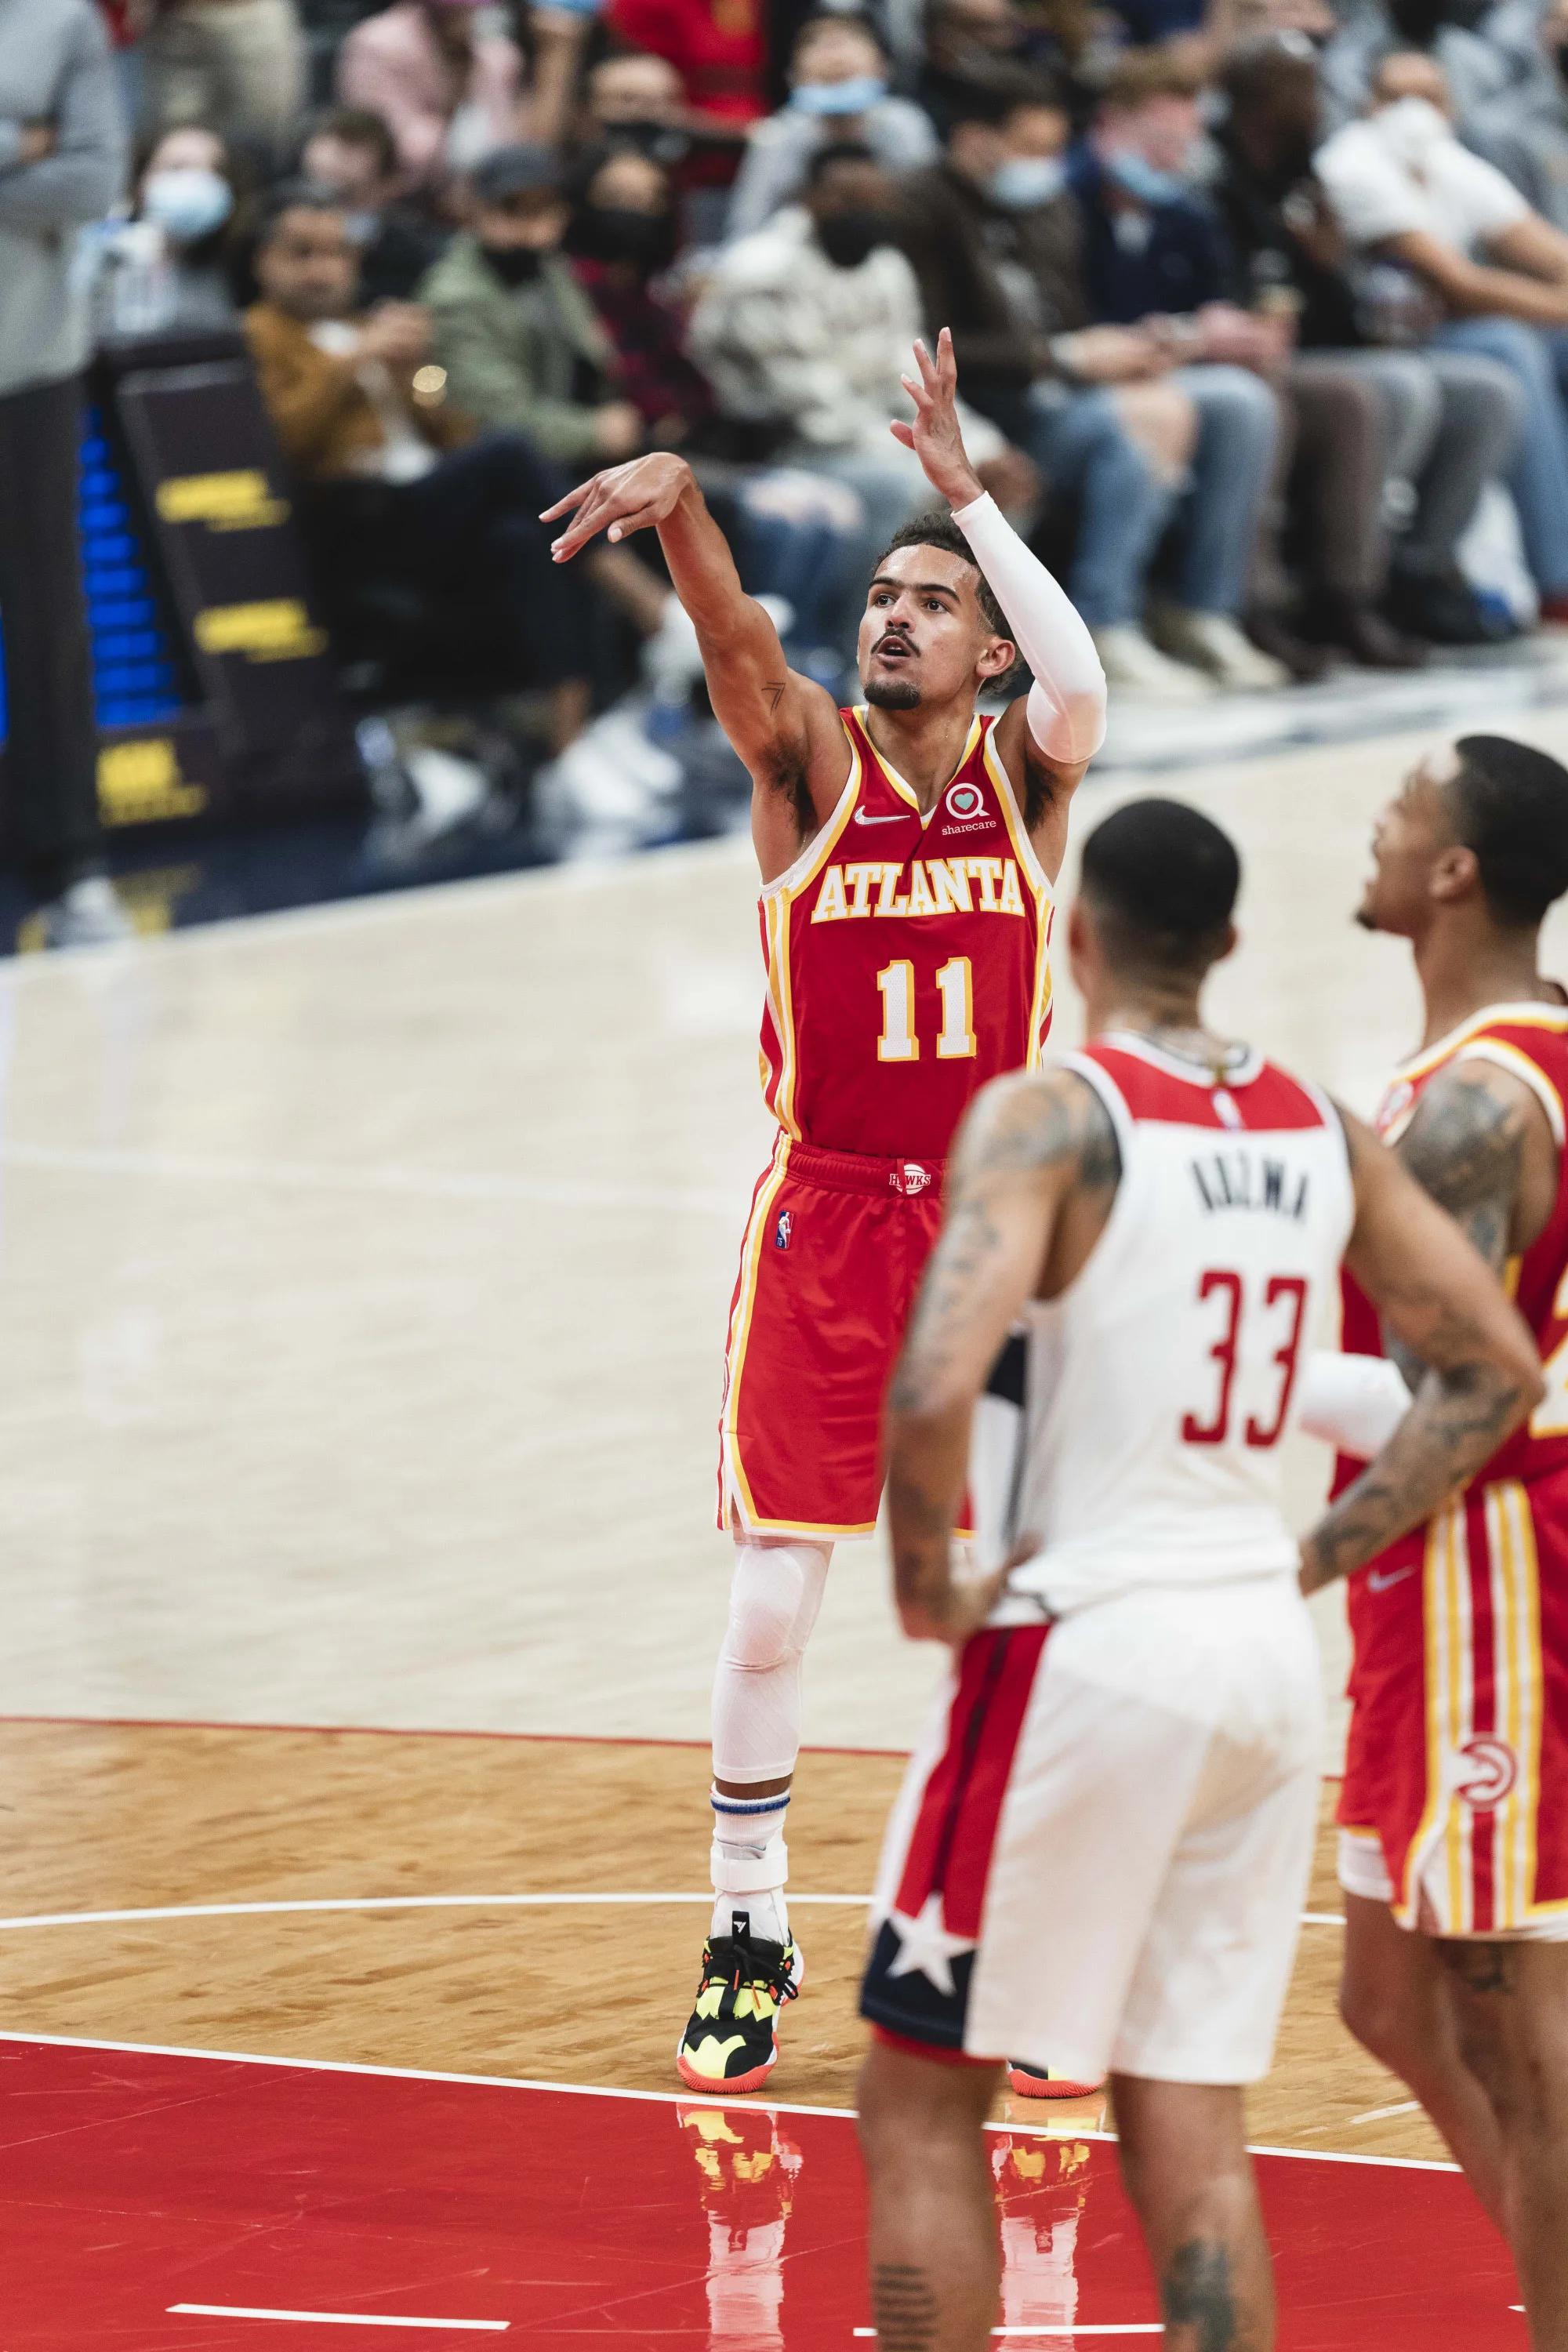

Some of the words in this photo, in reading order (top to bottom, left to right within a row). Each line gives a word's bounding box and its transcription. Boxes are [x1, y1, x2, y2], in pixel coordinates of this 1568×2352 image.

[941, 820, 996, 836] sharecare
[811, 856, 1025, 924] ATLANTA
[877, 956, 977, 1062] 11
[889, 1174, 931, 1185] HWKS
[1182, 1271, 1308, 1446] 33
